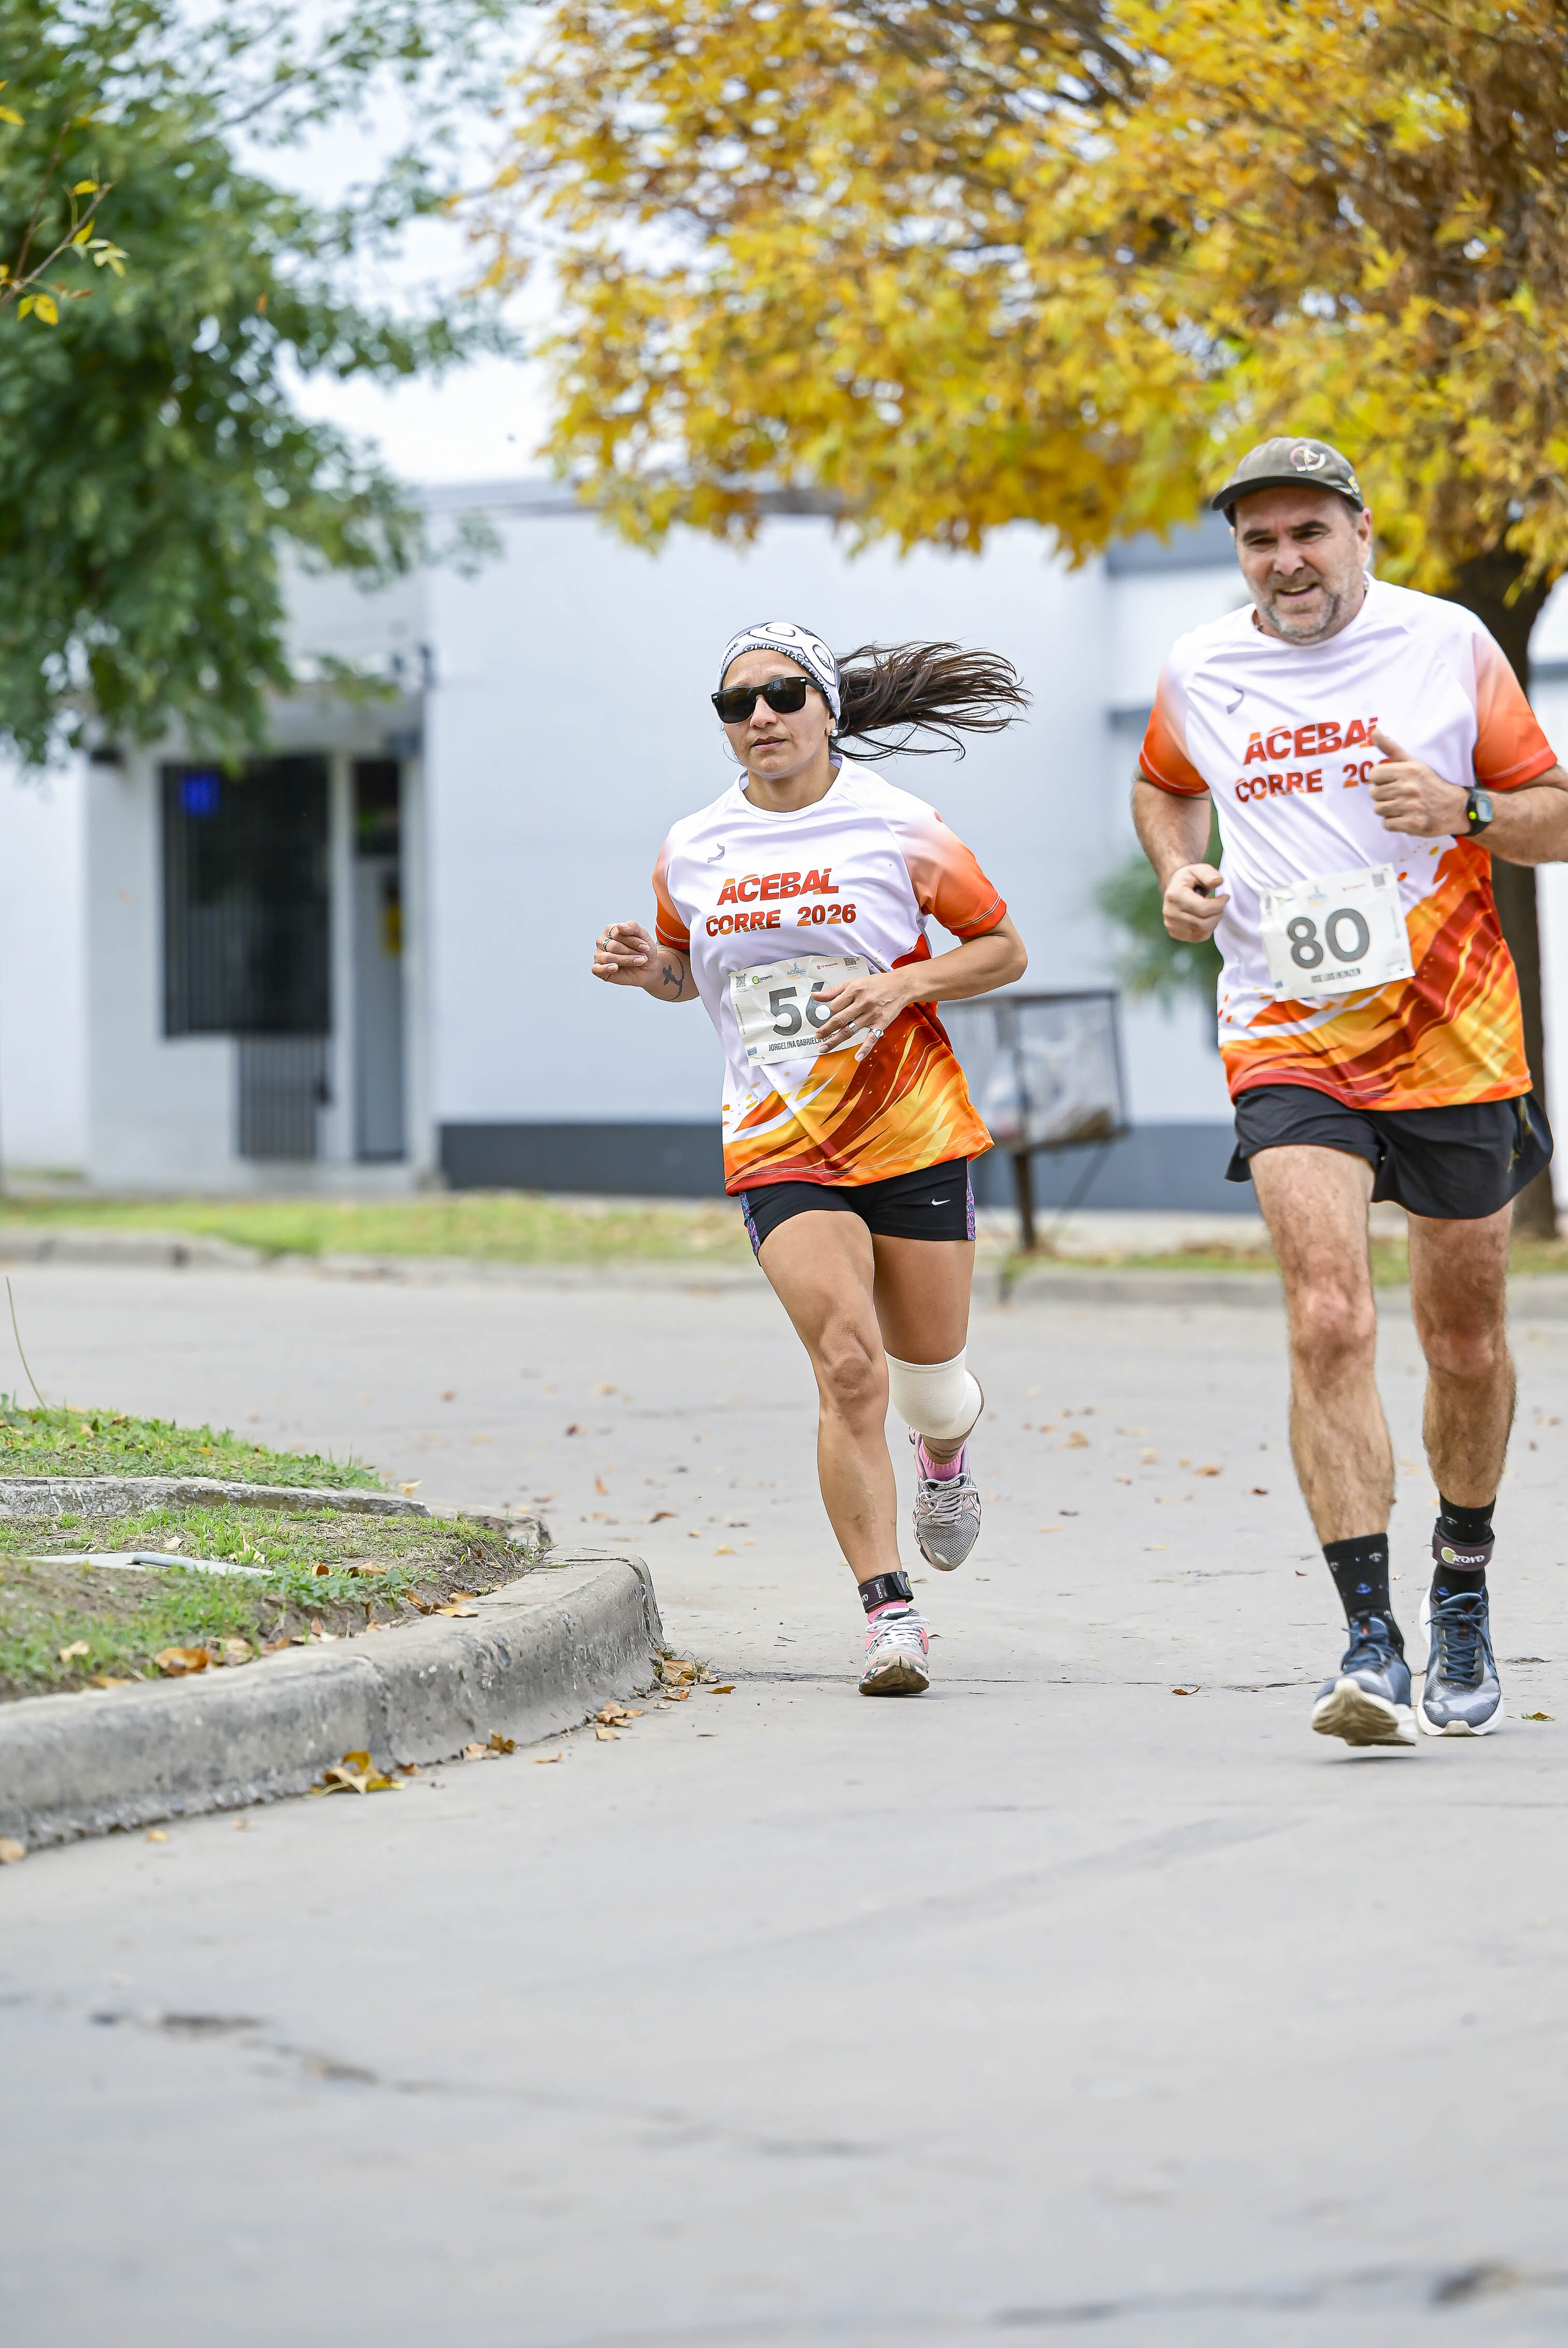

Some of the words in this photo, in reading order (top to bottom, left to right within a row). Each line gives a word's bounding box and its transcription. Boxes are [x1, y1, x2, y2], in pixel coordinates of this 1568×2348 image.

[1235, 768, 1323, 803] CORRE
[1342, 758, 1392, 788] 20
[717, 868, 839, 905] ACEBAL
[706, 909, 781, 937] CORRE
[796, 904, 857, 927] 2026
[1287, 909, 1370, 968] 80
[768, 981, 833, 1036] 56
[768, 1040, 796, 1052] JORGELINA
[796, 1036, 822, 1046] GABRIELA
